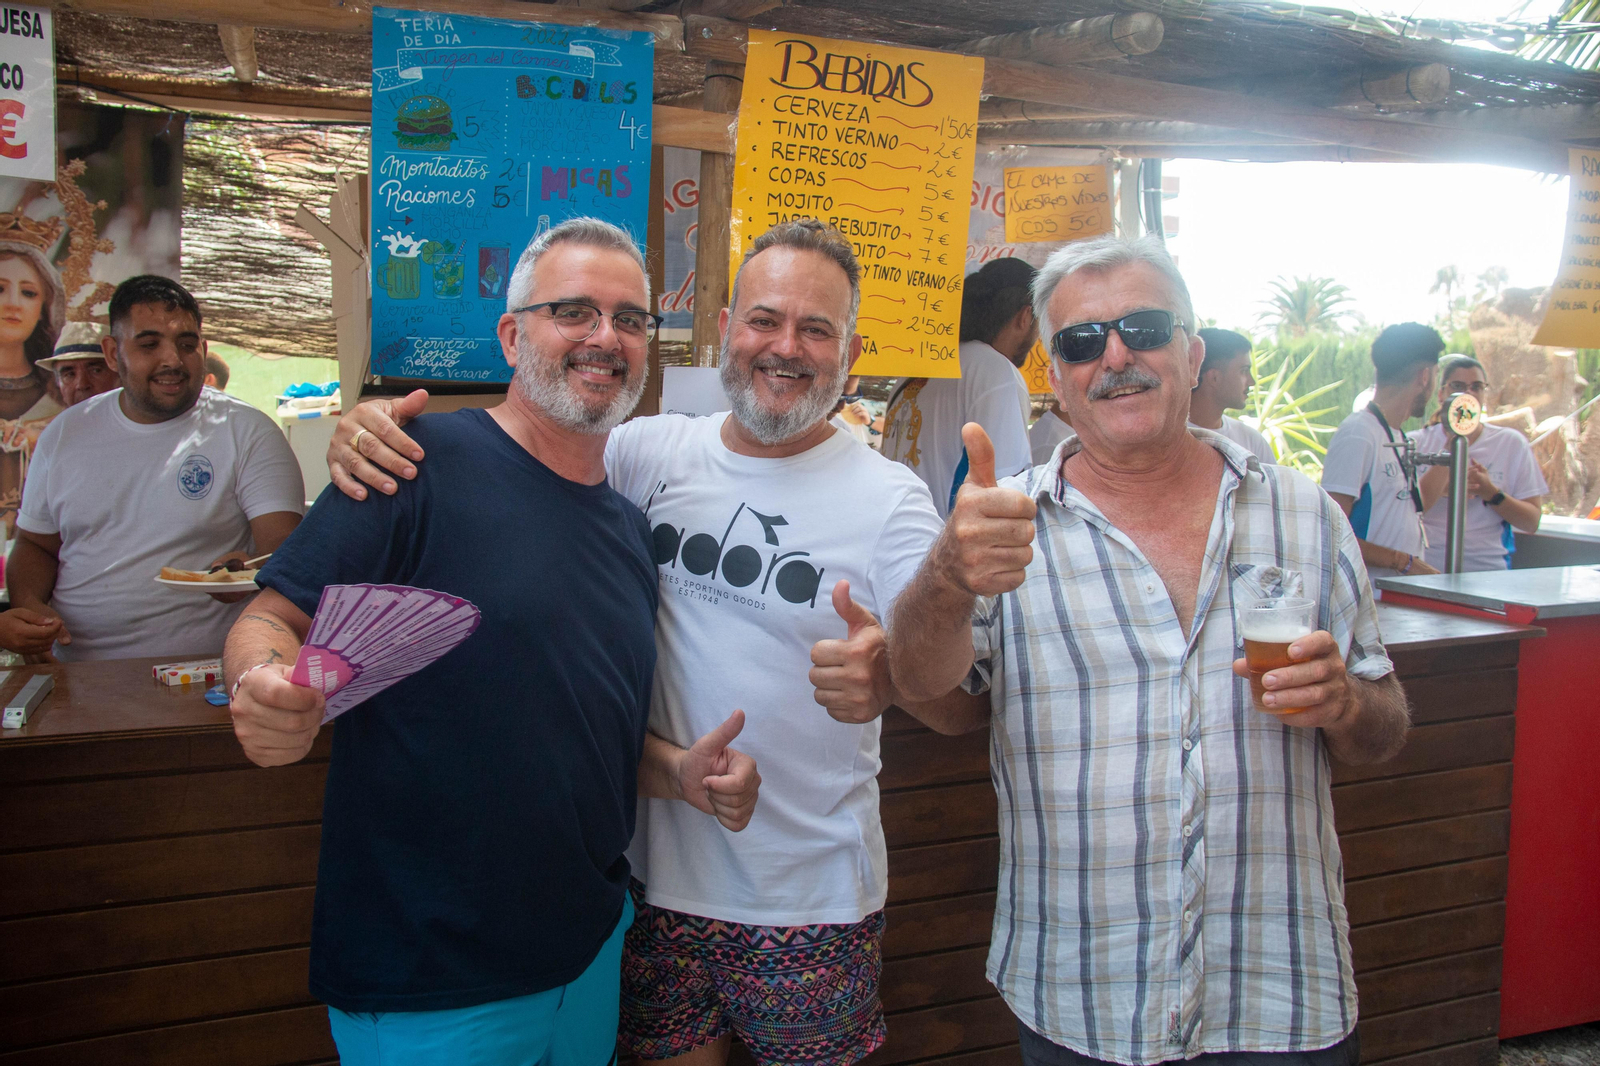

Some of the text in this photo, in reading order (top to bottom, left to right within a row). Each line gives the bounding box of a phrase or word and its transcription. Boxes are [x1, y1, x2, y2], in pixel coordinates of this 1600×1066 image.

[394, 15, 454, 32] FERIA
[403, 35, 423, 47] DE
[521, 26, 569, 47] 2022
[415, 49, 571, 82] Virgen del Carmen
[388, 81, 457, 109] BURGER
[575, 104, 616, 120] QUESO
[773, 94, 870, 124] CERVEZA
[522, 117, 592, 131] LONGANIZA
[520, 128, 553, 140] LOMO
[566, 130, 610, 144] QUESO
[773, 120, 899, 151] TINTO VERANO
[520, 139, 590, 154] MORCILLA
[771, 142, 867, 170] REFRESCOS
[541, 165, 633, 201] MIGAS
[768, 166, 826, 187] COPAS
[1007, 170, 1025, 189] EL
[1072, 173, 1095, 184] DE
[767, 193, 834, 212] MOJITO
[422, 206, 491, 218] LONGANIZA
[421, 216, 488, 230] MORCILLA
[829, 216, 901, 240] REBUJITO
[421, 228, 460, 239] LOMO
[864, 264, 870, 278] Y
[873, 264, 901, 282] TINTO
[907, 270, 946, 289] VERANO
[380, 300, 435, 317] Cerveza
[450, 317, 465, 335] 5
[414, 339, 479, 350] Cerveza
[413, 348, 466, 360] Mojito
[400, 365, 427, 376] Vino
[447, 368, 493, 379] Verano
[684, 580, 729, 600] SPORTING
[733, 595, 766, 611] GOODS
